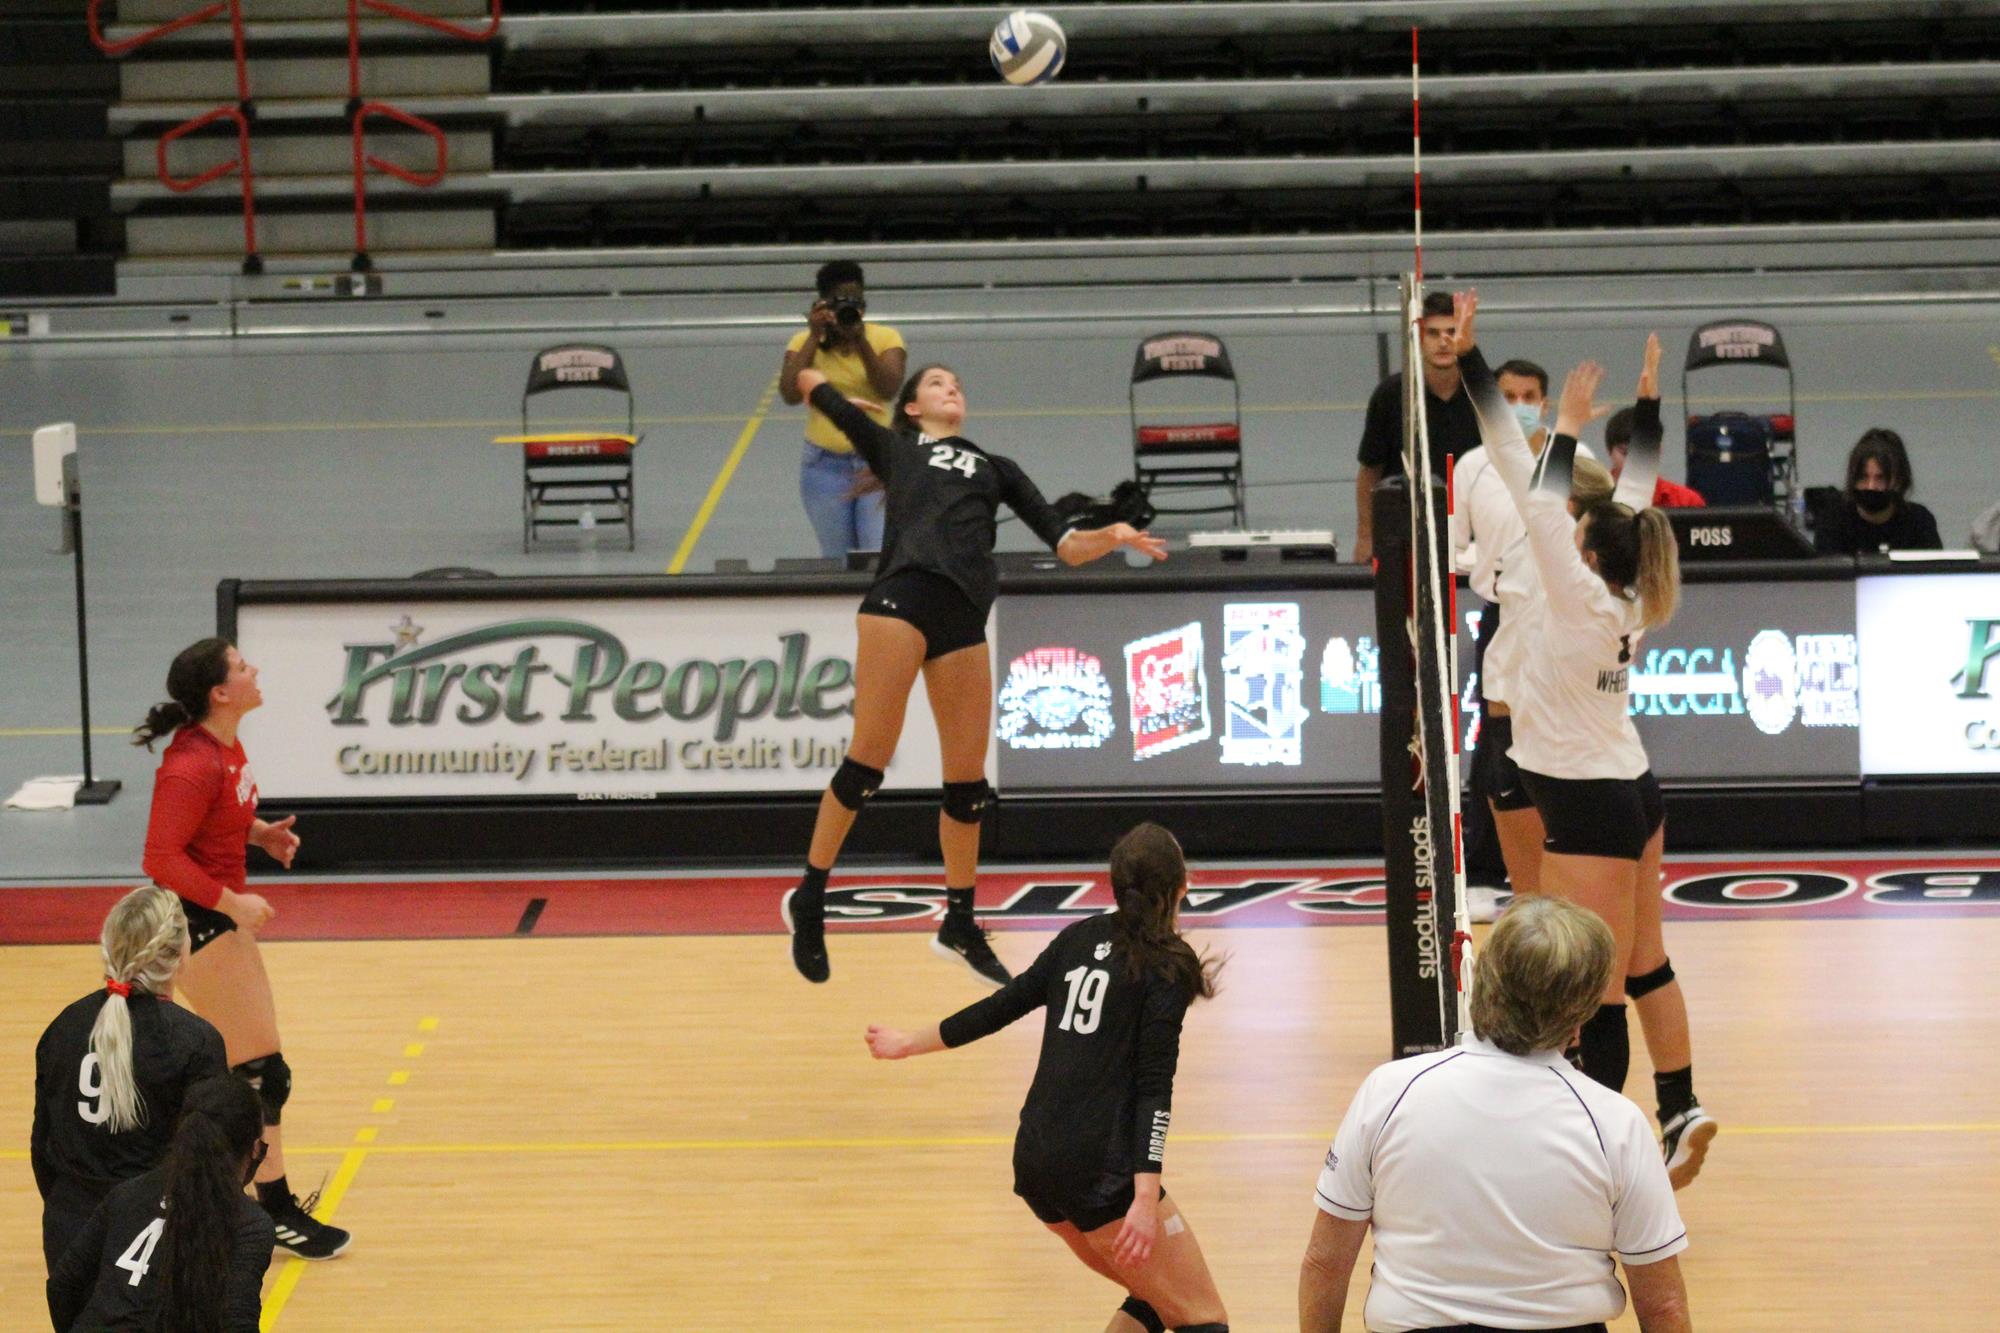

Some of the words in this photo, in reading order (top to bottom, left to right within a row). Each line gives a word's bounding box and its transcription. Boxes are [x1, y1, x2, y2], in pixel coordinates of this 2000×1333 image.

[928, 445, 977, 479] 24
[1690, 528, 1732, 546] POSS
[325, 634, 552, 727] First
[553, 618, 857, 743] People
[335, 743, 536, 781] Community
[547, 738, 669, 772] Federal
[678, 737, 782, 770] Credit
[789, 736, 852, 770] Uni
[1058, 965, 1110, 1035] 19
[77, 1052, 112, 1124] 9
[1148, 1109, 1171, 1163] BOBCATS
[114, 1217, 166, 1287] 4
